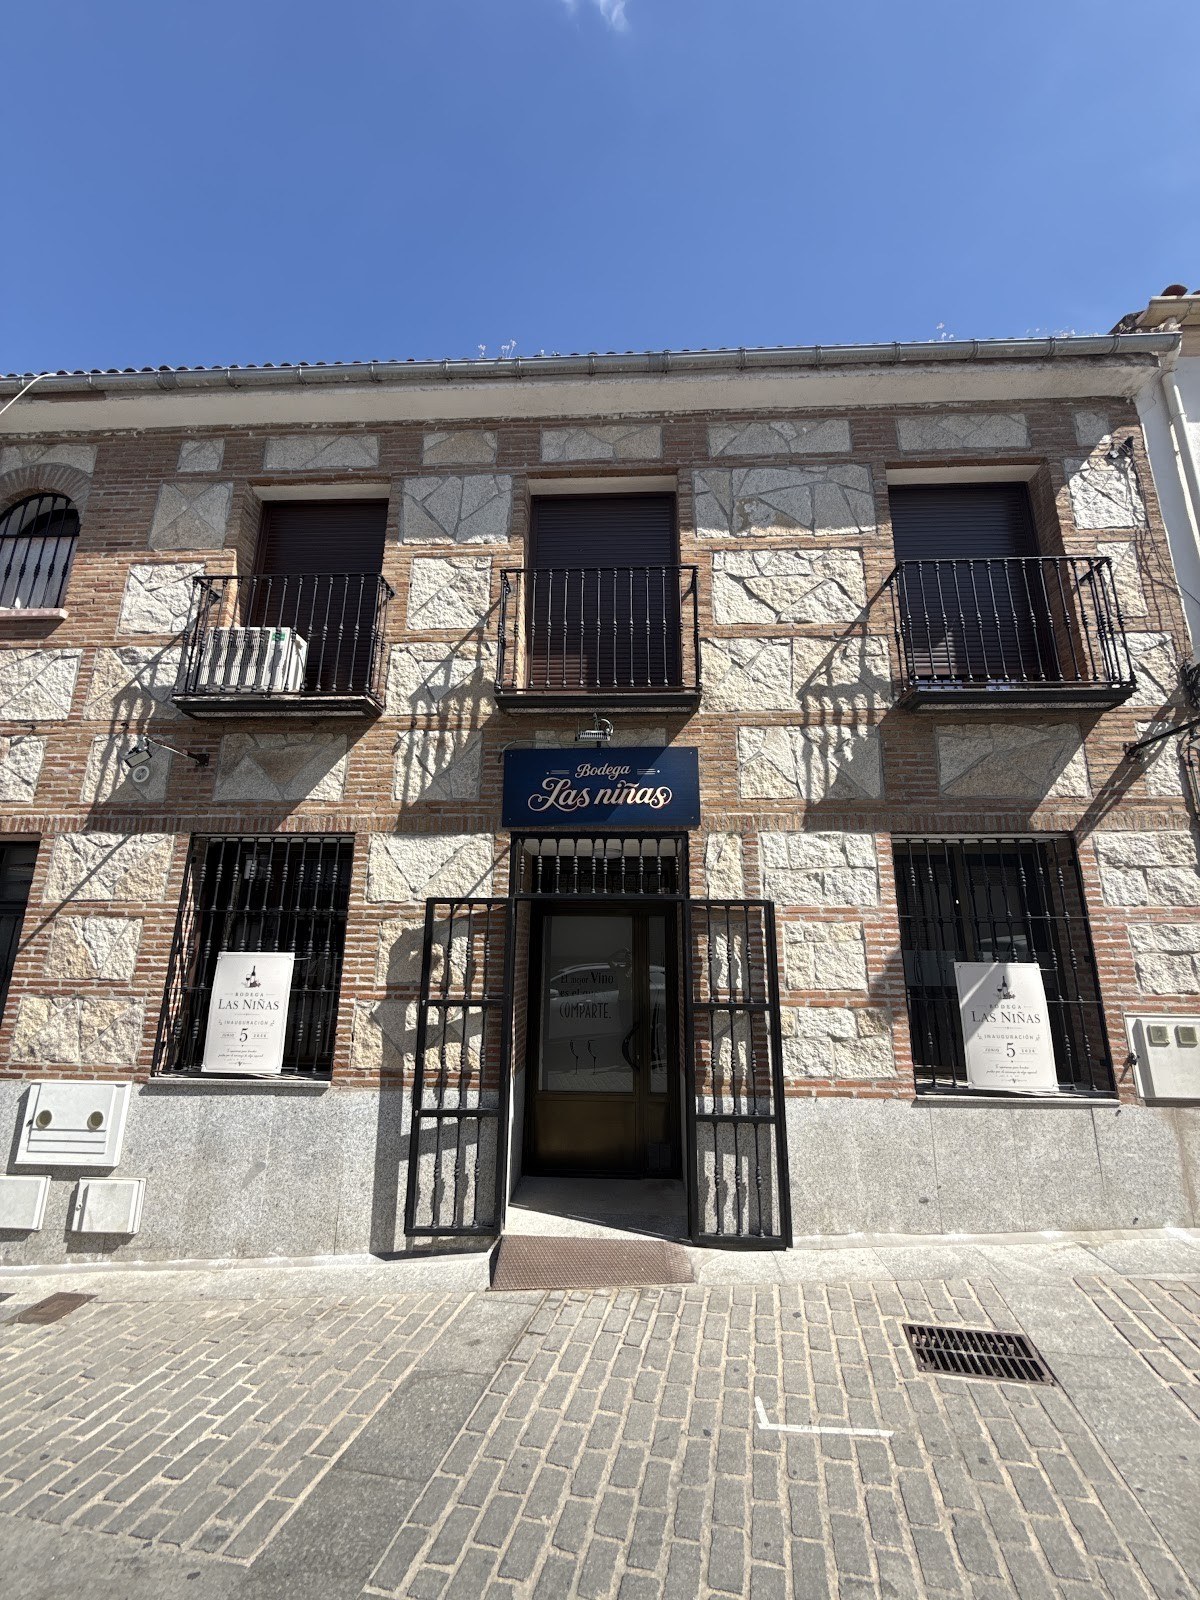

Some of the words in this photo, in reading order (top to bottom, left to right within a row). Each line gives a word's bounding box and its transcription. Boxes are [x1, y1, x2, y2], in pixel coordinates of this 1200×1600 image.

[575, 763, 631, 780] Bodega
[528, 777, 590, 811] Las
[593, 780, 672, 809] niñas
[560, 974, 568, 983] El
[571, 977, 589, 985] mejor
[590, 971, 614, 984] Vino
[218, 998, 239, 1010] LAS
[242, 998, 280, 1010] NIÑAS
[559, 1001, 612, 1019] COMPARTE.
[971, 1010, 996, 1023] LAS
[1000, 1011, 1041, 1024] NIÑAS
[239, 1027, 248, 1042] 5
[1006, 1042, 1016, 1058] 5
